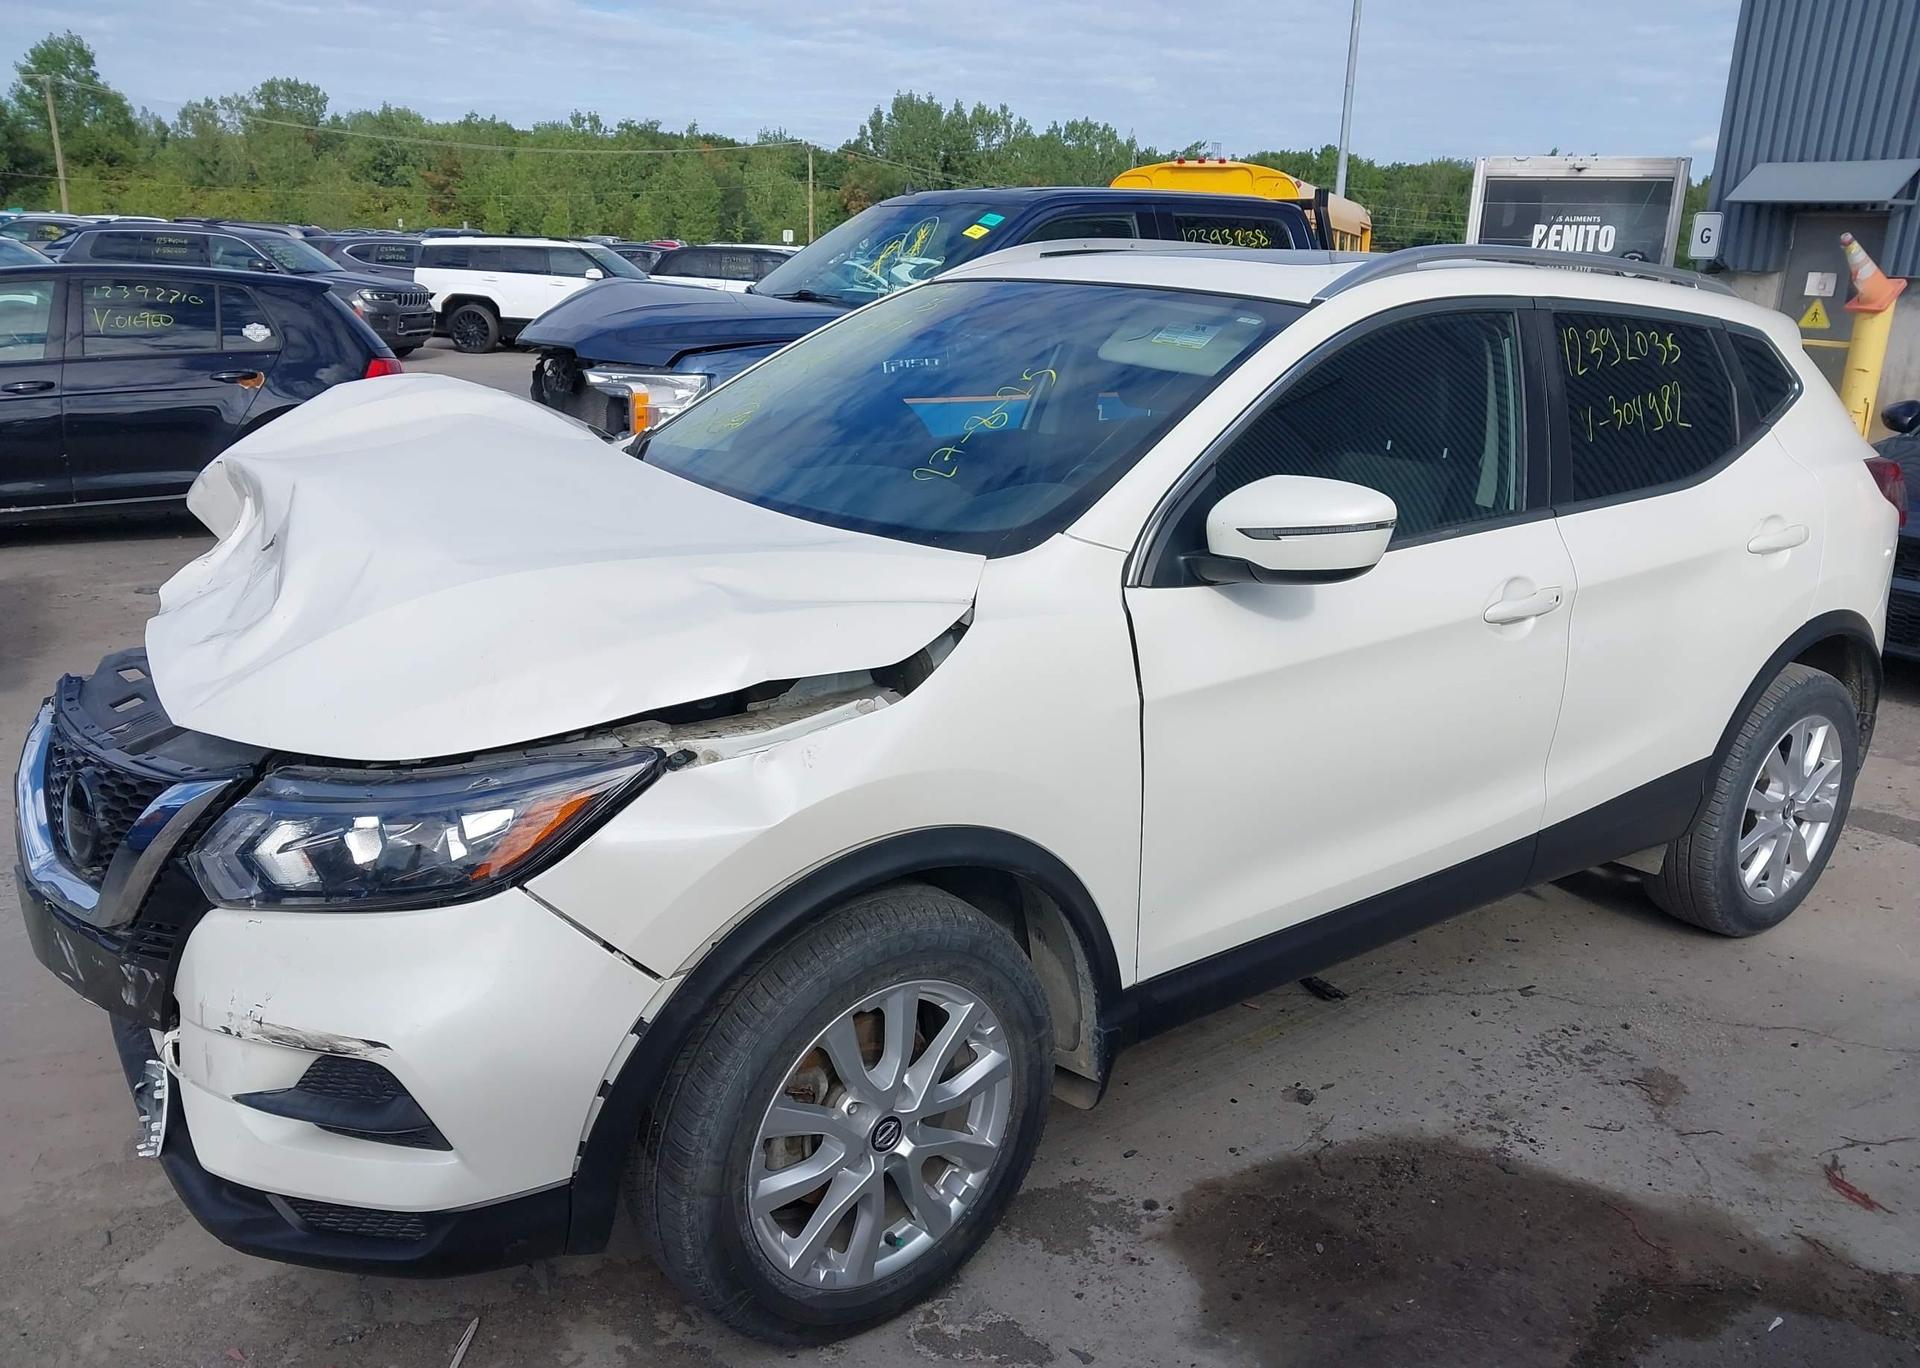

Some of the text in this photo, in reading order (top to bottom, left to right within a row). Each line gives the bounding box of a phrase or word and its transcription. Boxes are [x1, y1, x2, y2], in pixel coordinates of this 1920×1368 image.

[1564, 215, 1601, 223] ALIMENTS
[1531, 223, 1617, 253] BENITO
[1700, 227, 1712, 244] G
